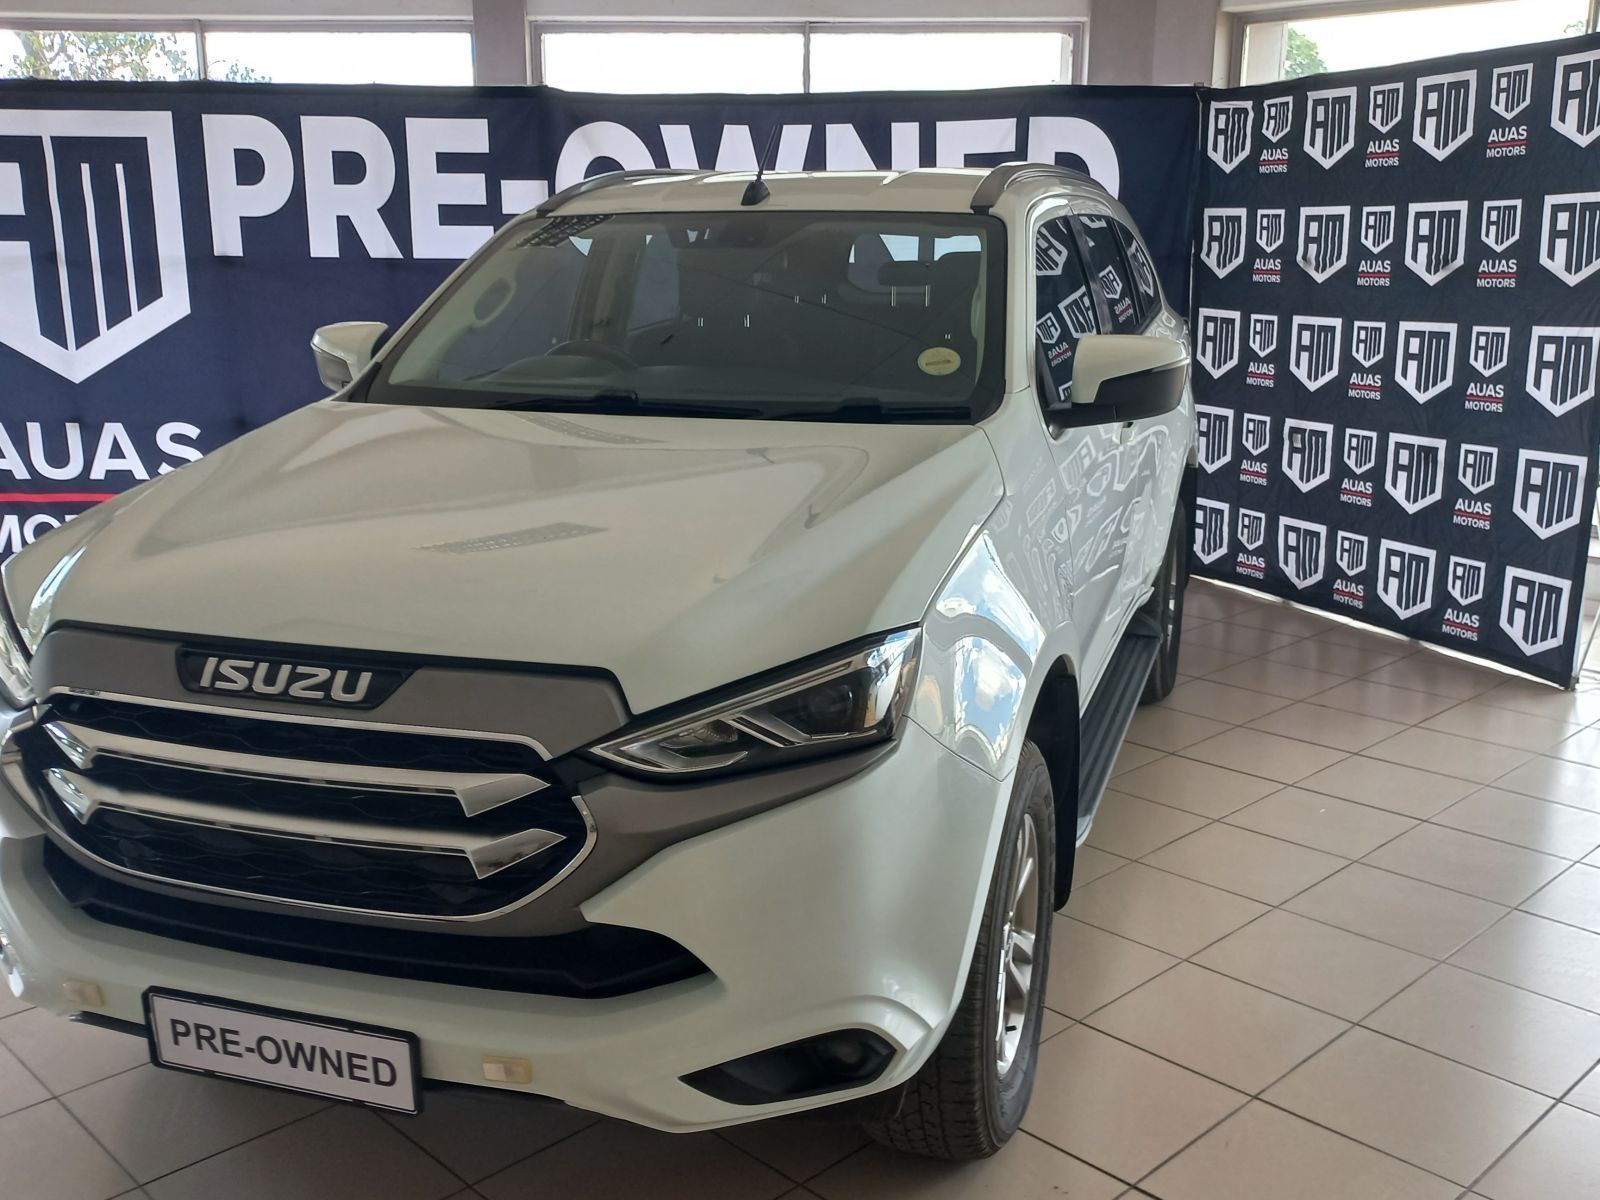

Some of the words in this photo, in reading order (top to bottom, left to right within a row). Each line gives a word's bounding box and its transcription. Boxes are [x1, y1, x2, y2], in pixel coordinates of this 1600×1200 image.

[1373, 88, 1400, 127] AM
[1494, 69, 1529, 114] AM
[1266, 101, 1290, 137] AM
[1310, 95, 1352, 160] AM
[1420, 79, 1471, 151] AM
[1212, 107, 1249, 166] AM
[1366, 138, 1400, 154] AUAS
[1487, 125, 1528, 144] AUAS
[1258, 163, 1288, 174] MOTORS
[1259, 147, 1289, 161] AUAS
[1364, 156, 1400, 168] MOTORS
[1485, 145, 1527, 159] MOTORS
[1259, 214, 1282, 248] AM
[1364, 211, 1391, 248] AM
[1485, 204, 1518, 246] AM
[1205, 215, 1242, 270] AM
[1302, 214, 1345, 274] AM
[1411, 210, 1462, 276] AM
[1252, 273, 1281, 283] MOTORS
[1253, 257, 1282, 271] AUAS
[1358, 259, 1392, 273] AUAS
[1478, 258, 1518, 274] AUAS
[1356, 276, 1391, 287] MOTORS
[1476, 277, 1516, 288] MOTORS
[1201, 316, 1236, 371] AM
[1253, 319, 1275, 352] AM
[1355, 326, 1382, 362] AM
[1474, 331, 1506, 371] AM
[1247, 361, 1275, 376] AUAS
[1295, 323, 1337, 383] AM
[1401, 330, 1451, 394] AM
[1246, 376, 1275, 388] MOTORS
[1349, 372, 1382, 387] AUAS
[1534, 335, 1594, 406] AM
[1347, 388, 1381, 401] MOTORS
[1464, 400, 1504, 413] MOTORS
[1466, 382, 1505, 399] AUAS
[1246, 418, 1268, 451] AM
[1347, 433, 1374, 469] AM
[1240, 458, 1268, 474] AUAS
[1288, 426, 1328, 484] AM
[1462, 449, 1494, 488] AM
[1239, 473, 1268, 486] MOTORS
[1340, 477, 1373, 495] AUAS
[1391, 442, 1440, 505] AM
[1339, 493, 1372, 508] MOTORS
[1454, 497, 1492, 516] AUAS
[1520, 459, 1580, 530] AM
[1241, 513, 1263, 545] AM
[1452, 514, 1491, 530] MOTORS
[1236, 552, 1266, 568] AUAS
[1284, 524, 1321, 582] AM
[1339, 536, 1365, 571] AM
[1332, 578, 1364, 597] AUAS
[1382, 548, 1430, 611] AM
[1452, 562, 1482, 600] AM
[1443, 607, 1480, 628] AUAS
[1507, 575, 1564, 647] AM
[200, 656, 372, 702] ISUZU
[169, 1017, 397, 1088] PRE-OWNED
